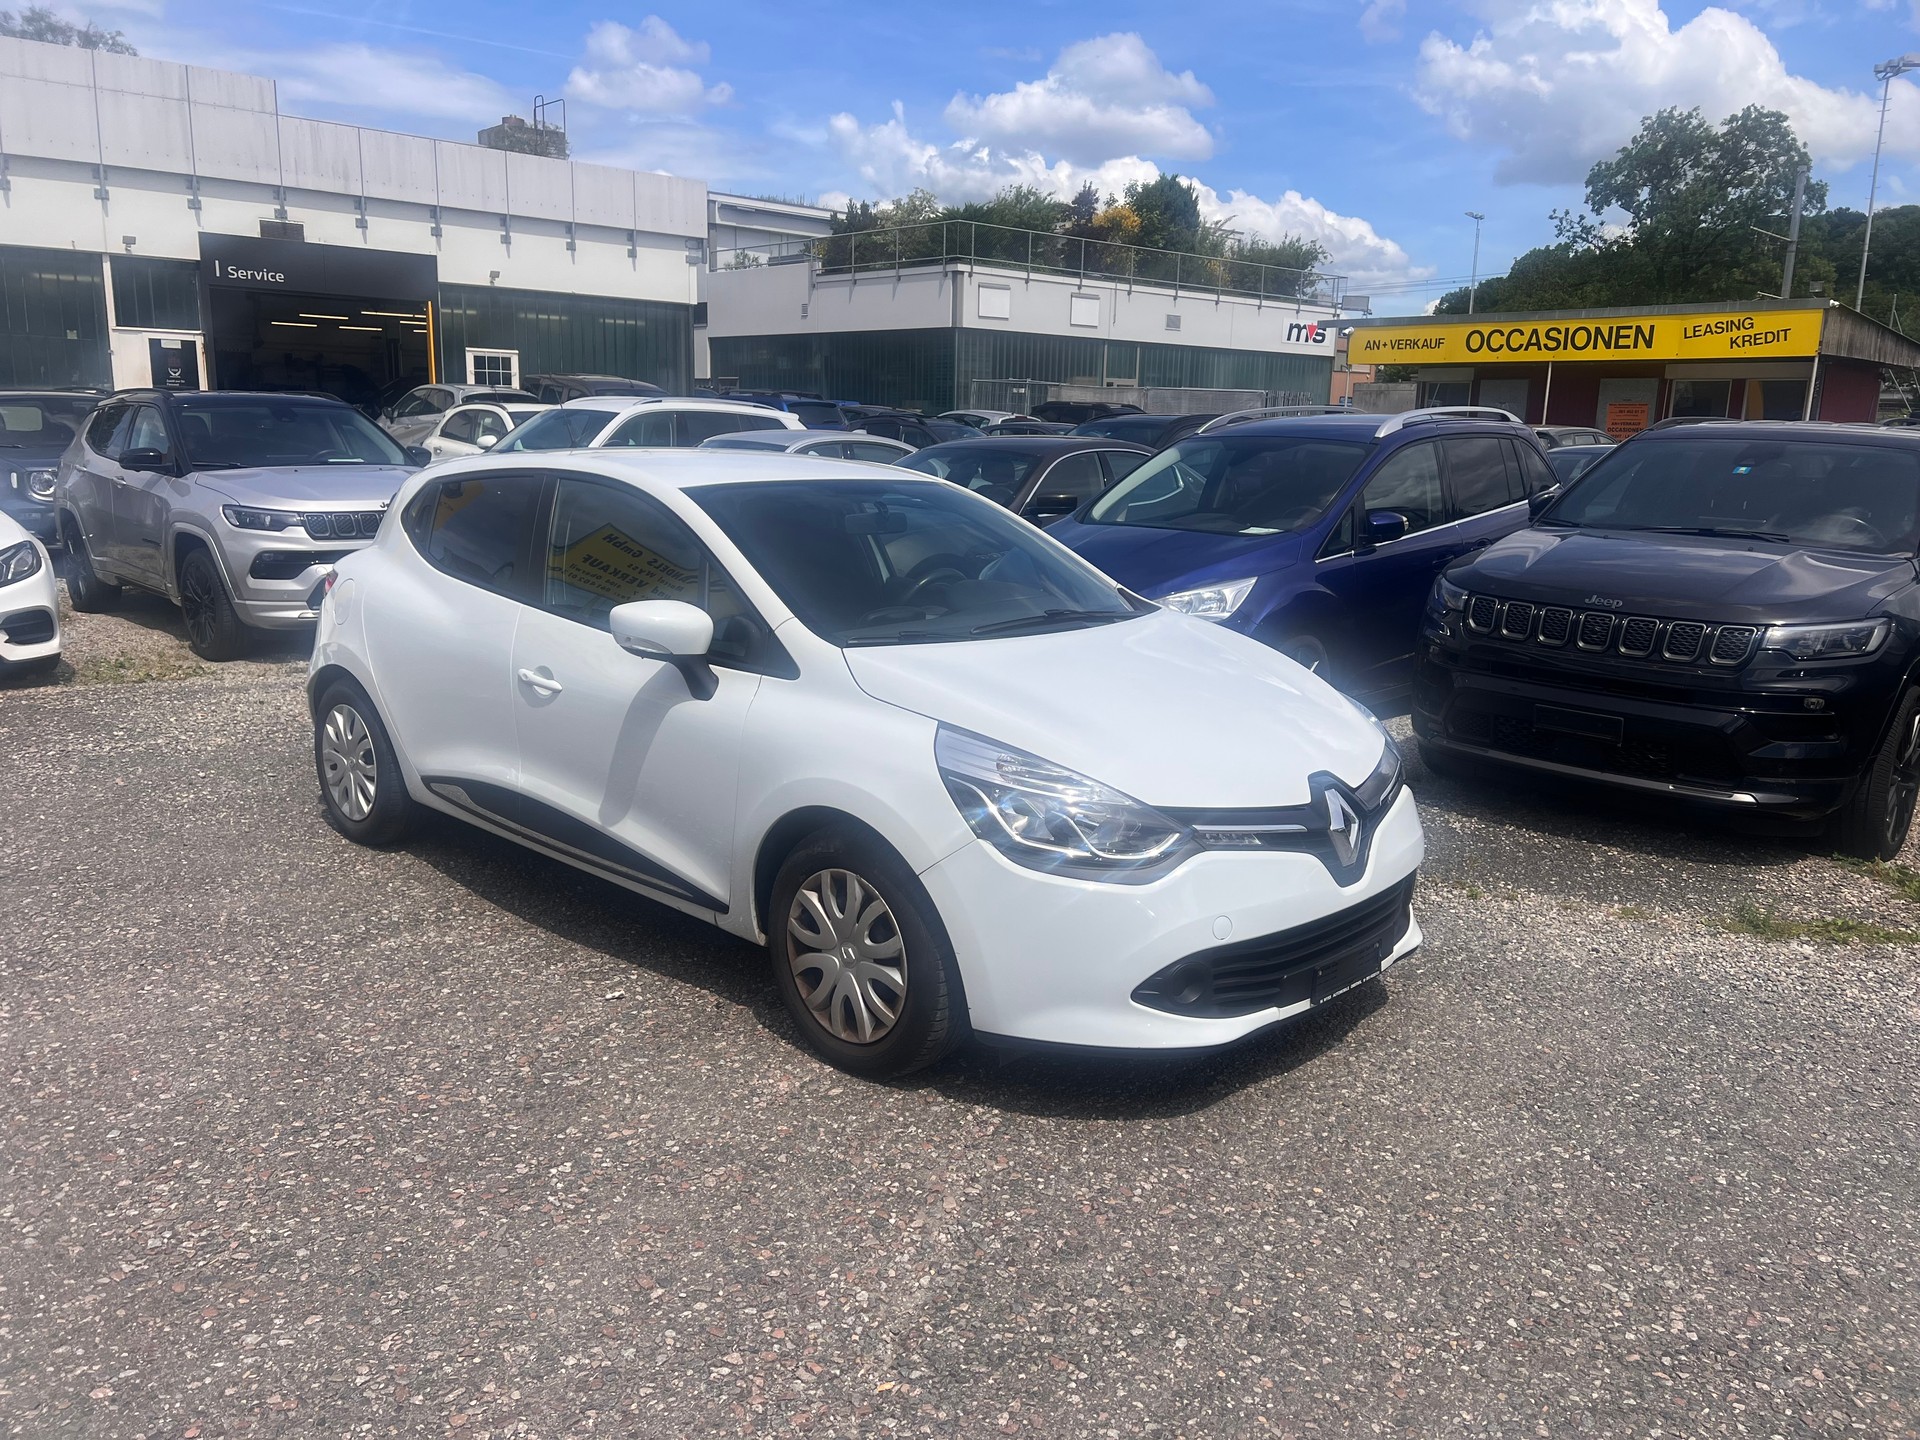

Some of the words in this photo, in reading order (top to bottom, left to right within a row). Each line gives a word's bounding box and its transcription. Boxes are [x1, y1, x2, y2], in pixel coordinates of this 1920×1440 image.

[227, 265, 285, 282] Service
[1683, 316, 1754, 339] LEASING
[1465, 324, 1655, 353] OCCASIONEN
[1729, 328, 1792, 349] KREDIT
[1584, 594, 1623, 609] Jeep
